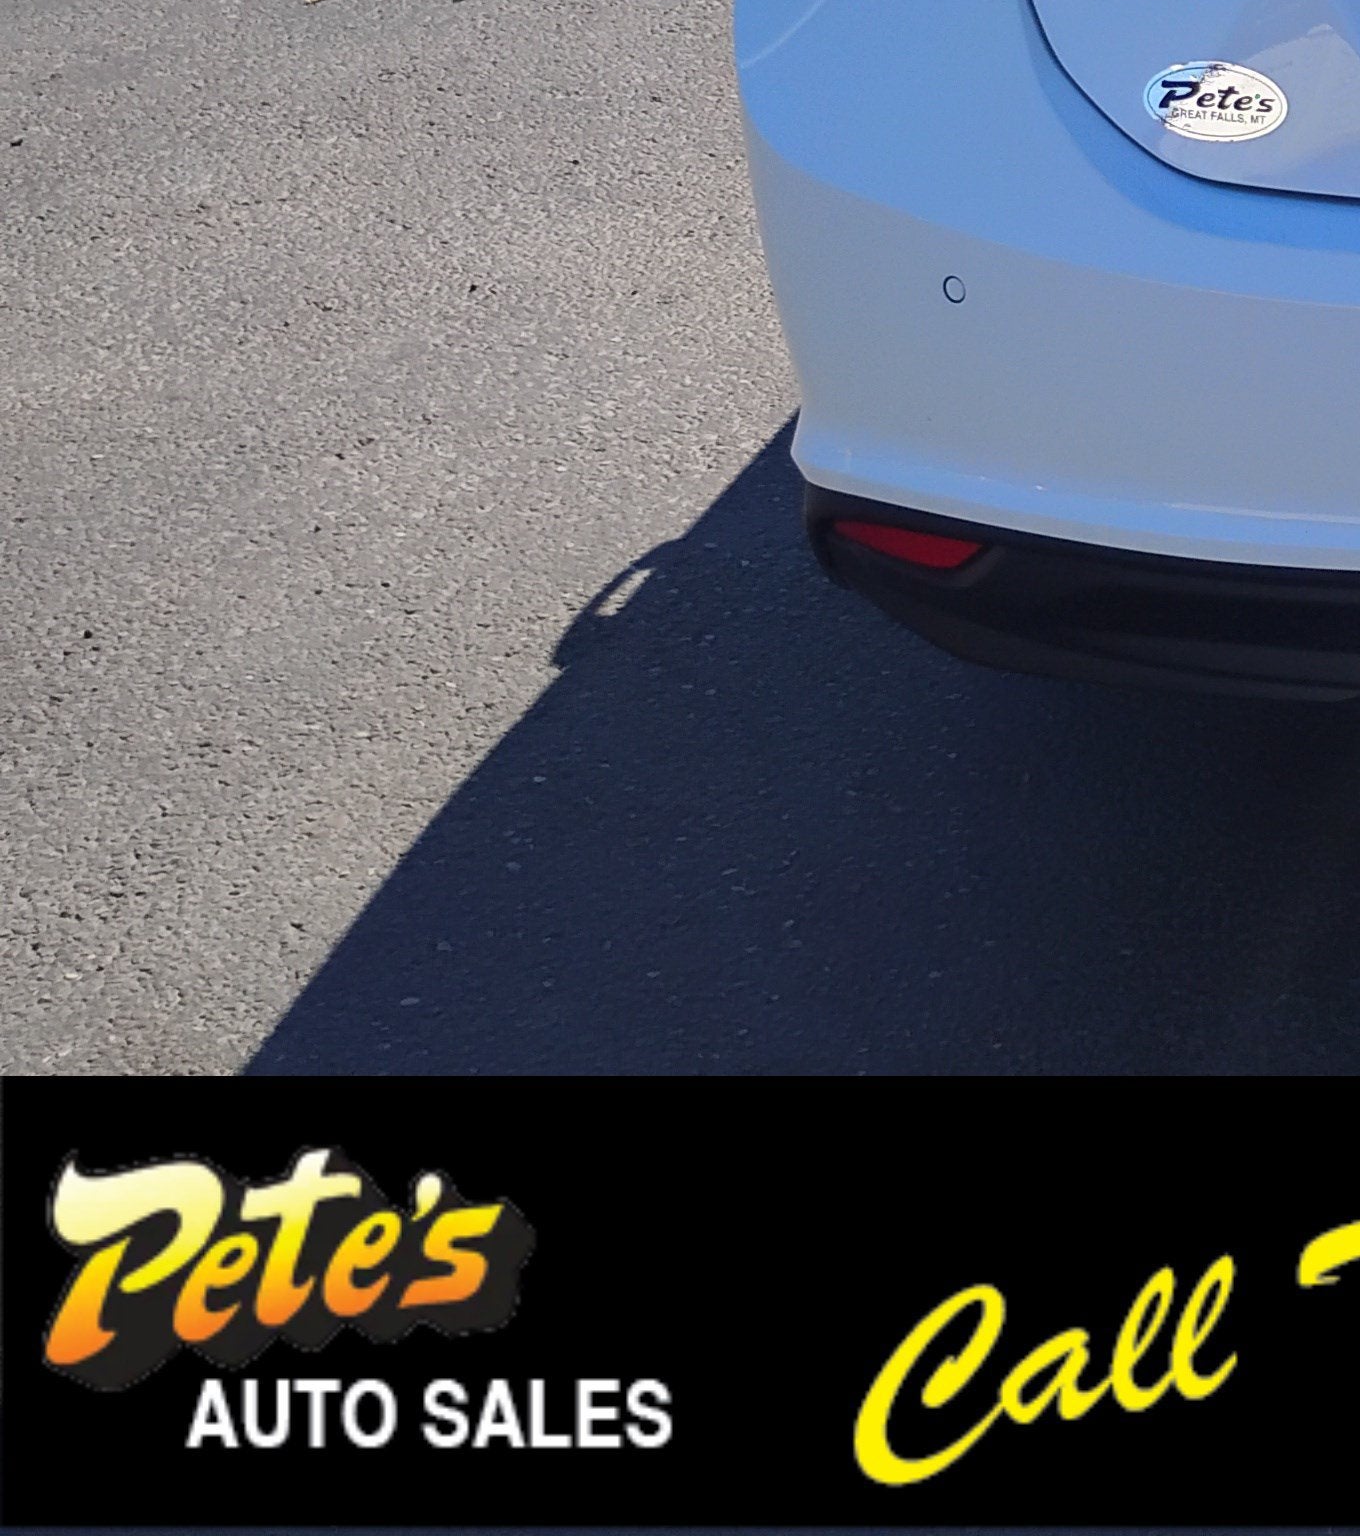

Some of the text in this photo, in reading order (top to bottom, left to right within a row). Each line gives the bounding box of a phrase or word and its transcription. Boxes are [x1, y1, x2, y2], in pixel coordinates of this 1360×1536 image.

[1159, 79, 1275, 112] Pete's
[1172, 107, 1207, 120] GREAT
[1250, 115, 1267, 124] MT
